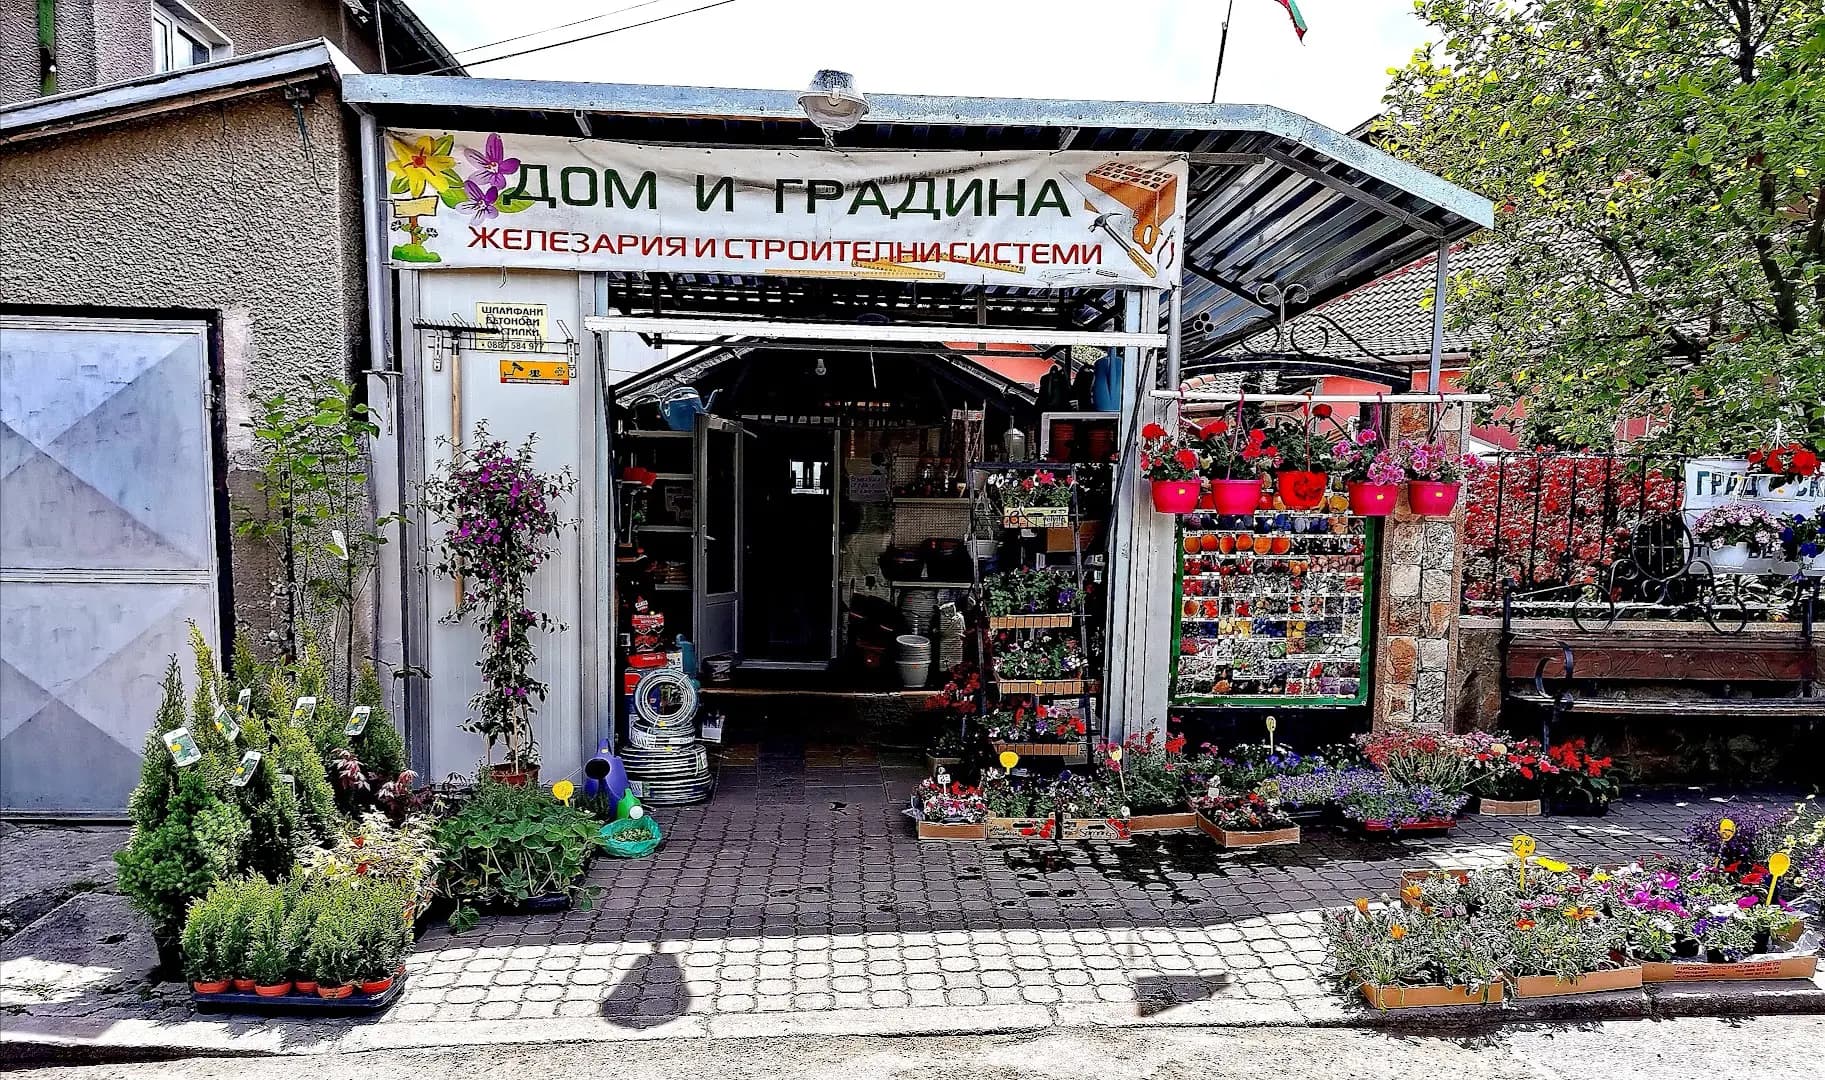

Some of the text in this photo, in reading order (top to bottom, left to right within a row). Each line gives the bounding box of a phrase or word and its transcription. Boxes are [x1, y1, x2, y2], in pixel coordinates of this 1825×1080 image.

[502, 163, 1072, 221] ДОМ И ГРАДИНА
[467, 225, 1102, 266] ЖЕЛЕЗАРИЯ И СТРОИТЕЛНИ СИСТЕМИ
[481, 306, 544, 316] ШЛАЙФАНИ
